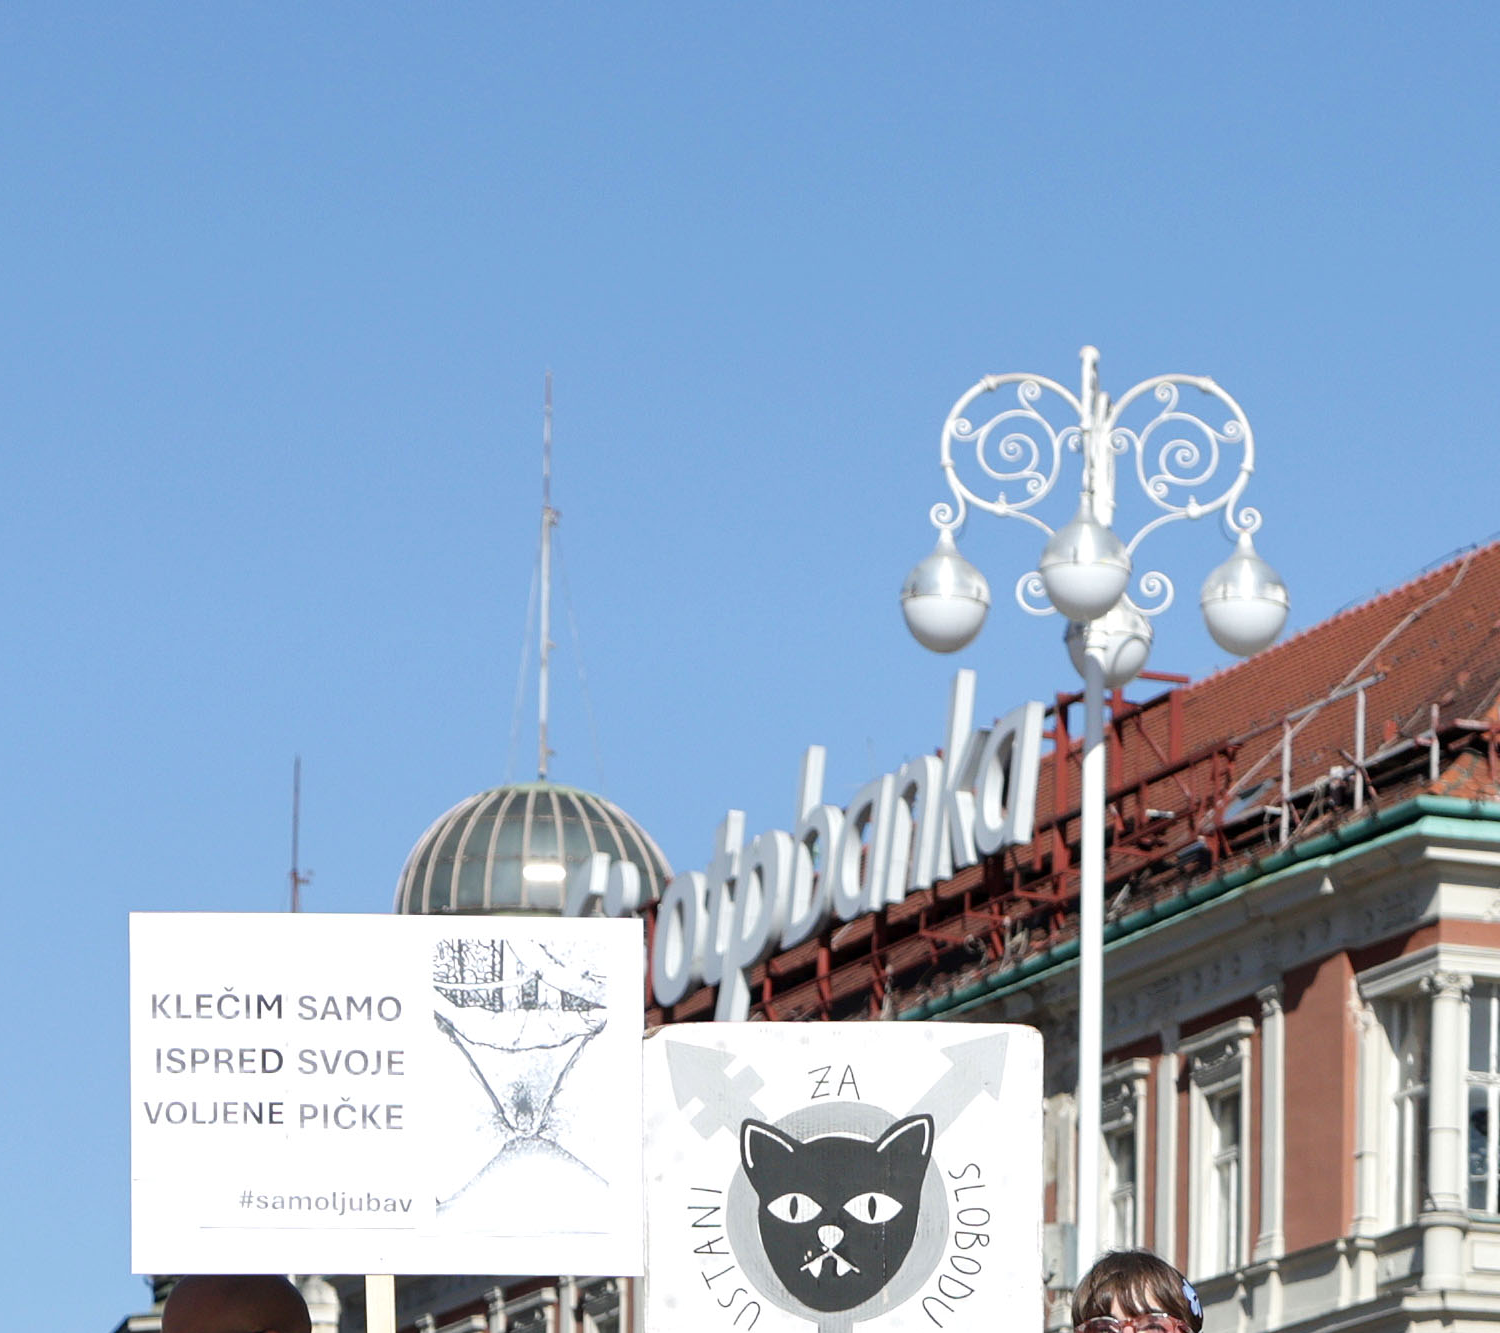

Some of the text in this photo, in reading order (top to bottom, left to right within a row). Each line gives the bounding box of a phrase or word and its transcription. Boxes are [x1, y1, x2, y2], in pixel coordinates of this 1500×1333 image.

[151, 986, 403, 1022] KLEČIM SAMO
[155, 1047, 406, 1078] ISPRED SVOJE
[143, 1096, 404, 1131] VOLJENE PIČKE
[239, 1189, 413, 1217] #samoljubav
[687, 1064, 991, 1332] USTANI ZA SLOBODU
